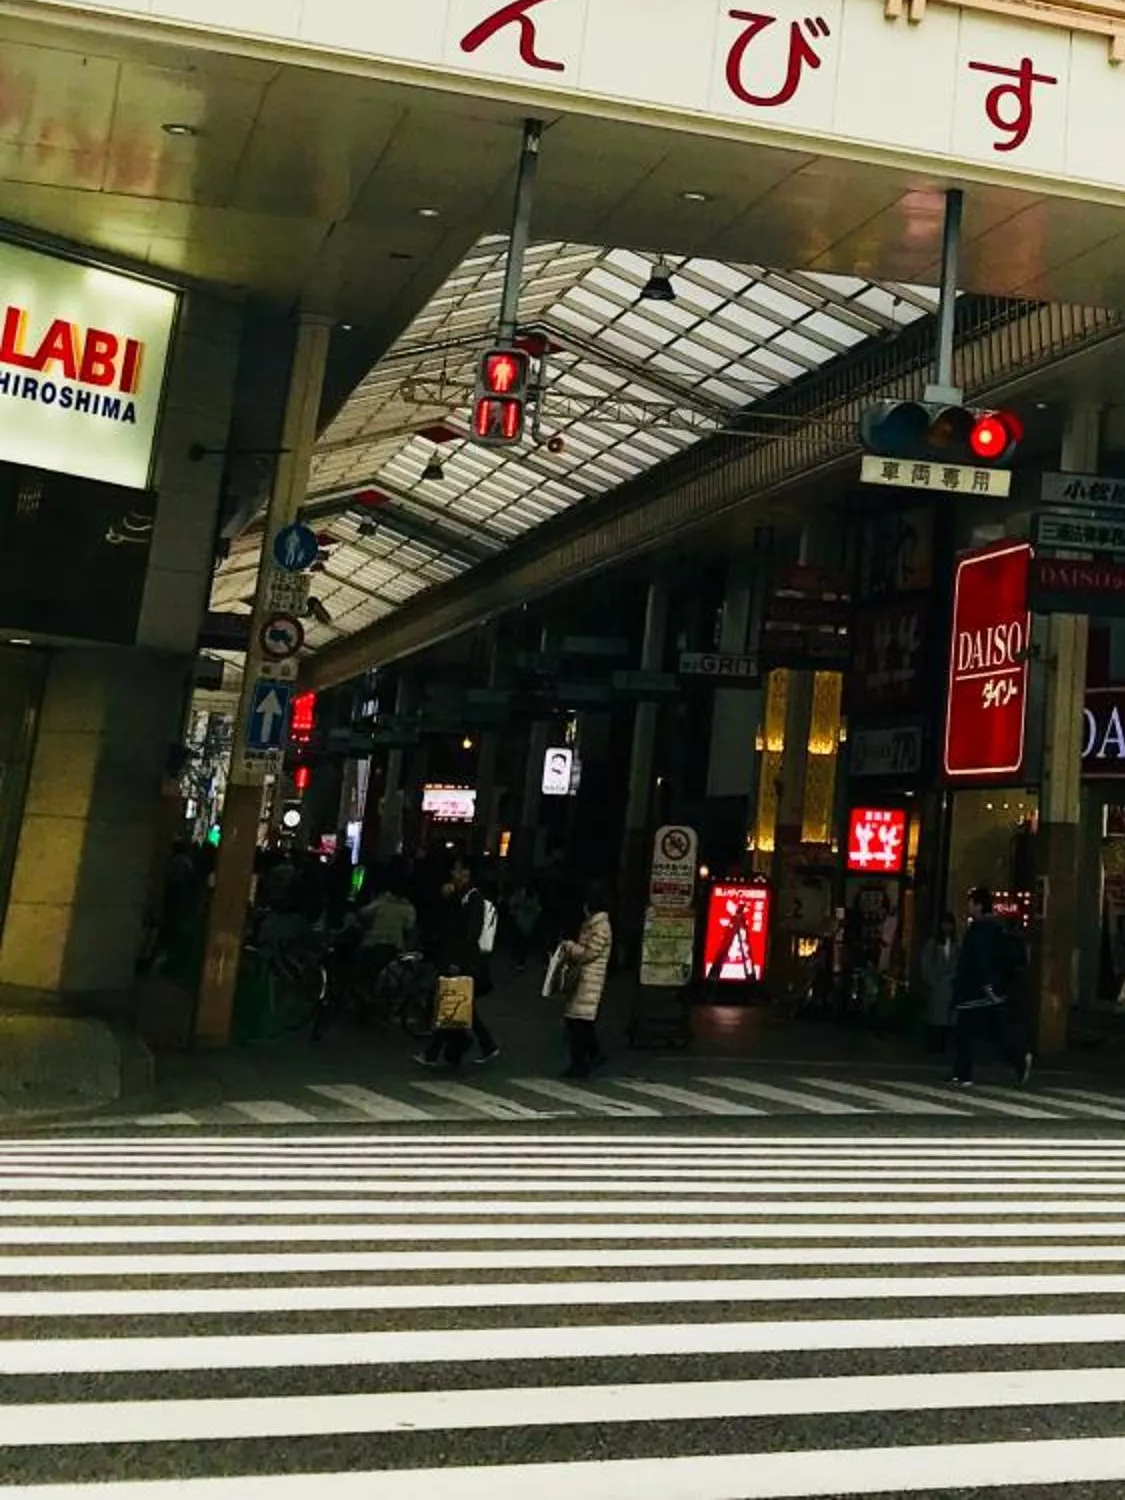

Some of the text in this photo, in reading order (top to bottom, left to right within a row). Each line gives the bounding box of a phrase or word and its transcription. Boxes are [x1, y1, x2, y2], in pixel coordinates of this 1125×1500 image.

[0, 306, 140, 394] LABI
[0, 371, 136, 424] HIROSHIMA
[880, 461, 990, 493] 車両専用
[958, 622, 1021, 671] DAISO
